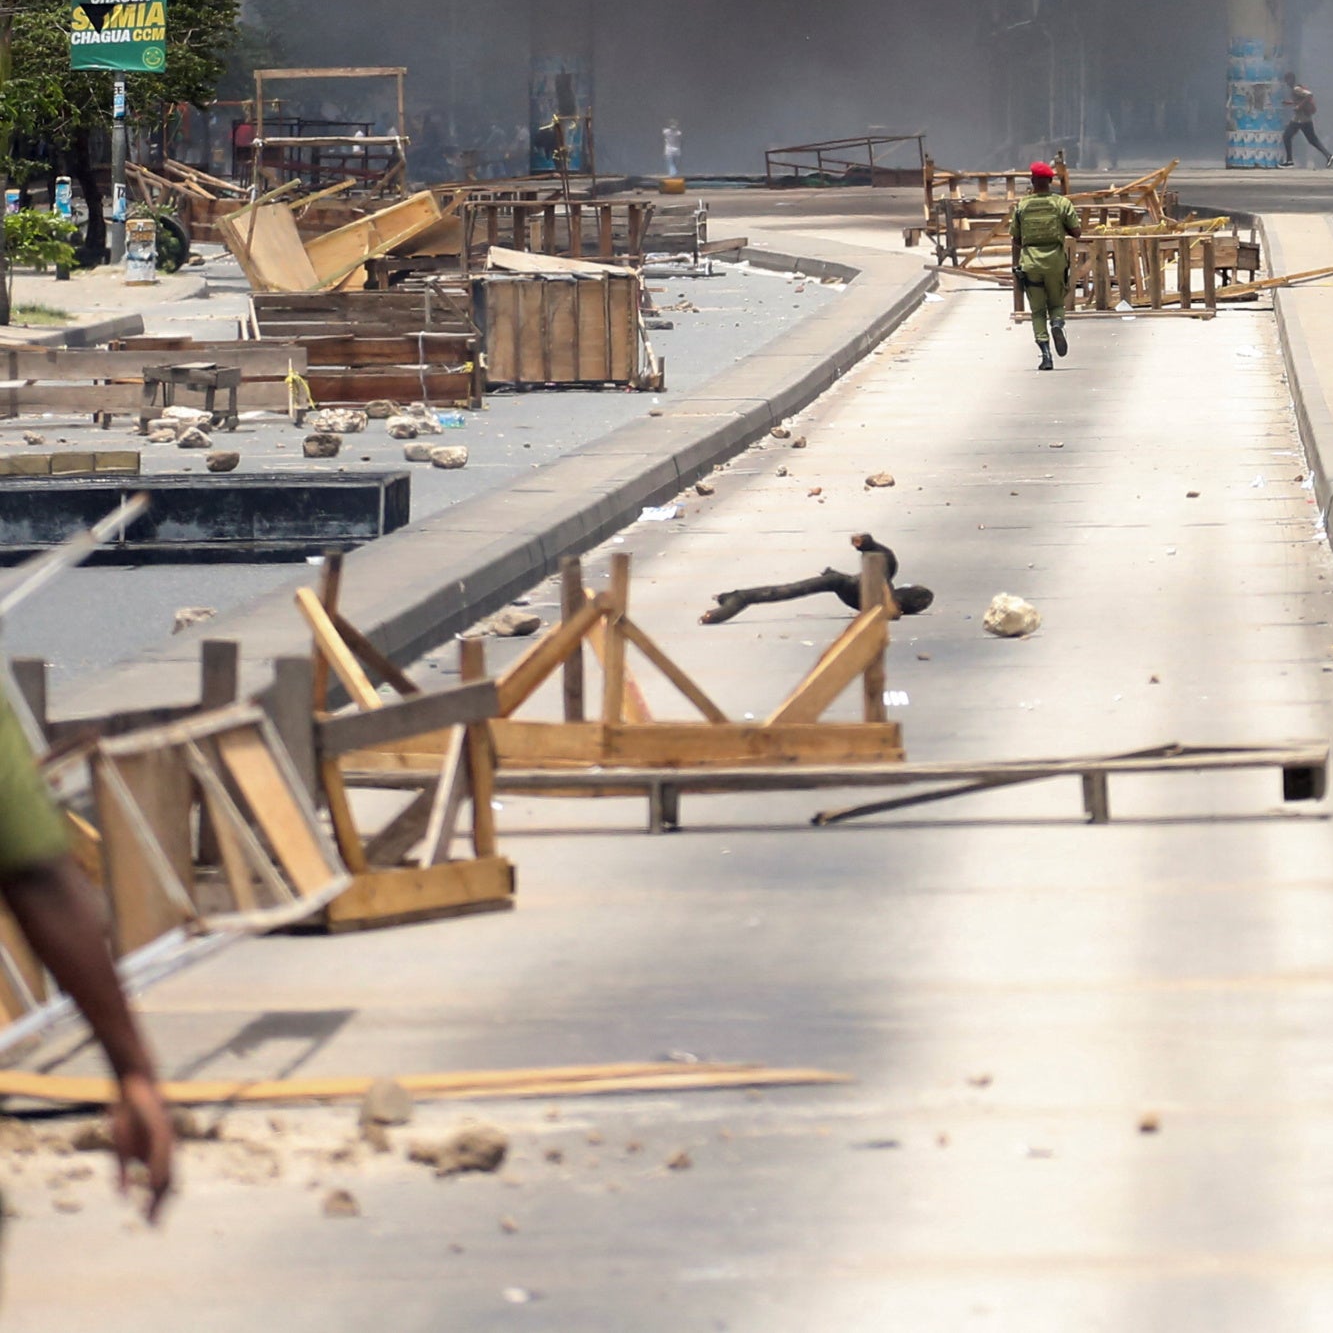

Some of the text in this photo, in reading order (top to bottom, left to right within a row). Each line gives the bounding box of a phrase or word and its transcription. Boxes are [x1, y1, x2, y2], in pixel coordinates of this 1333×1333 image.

[71, 1, 166, 31] SMIA
[70, 27, 166, 45] CHAGUA CCM
